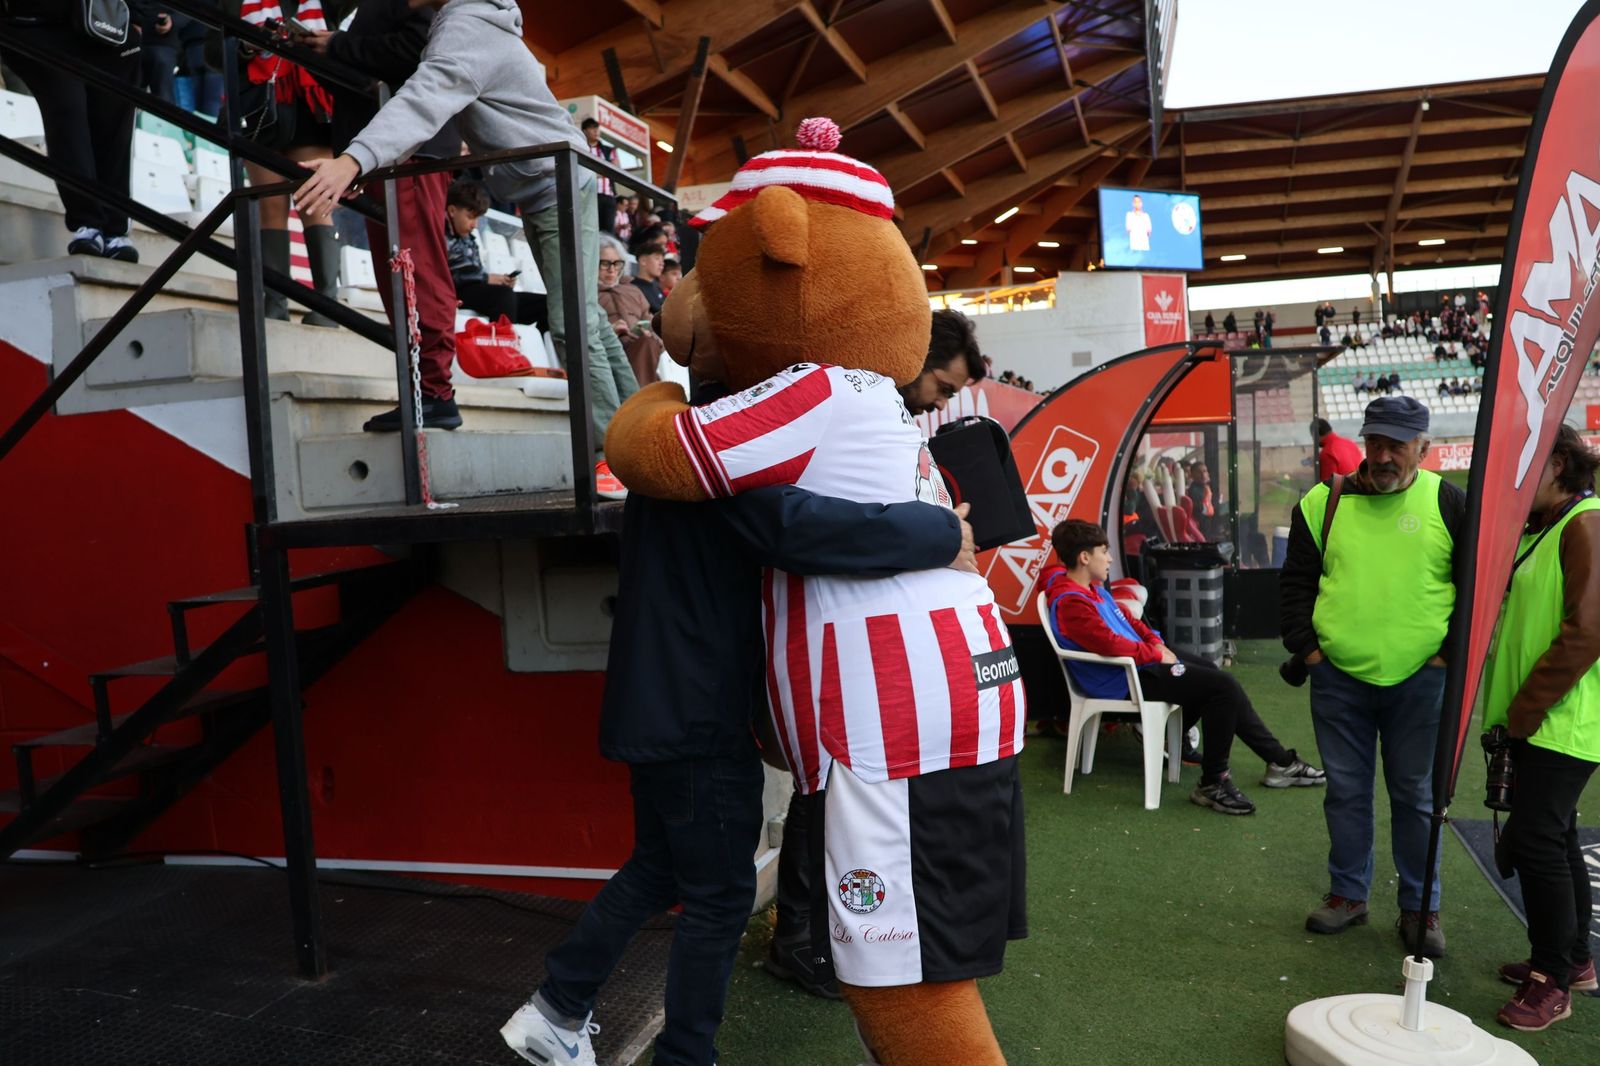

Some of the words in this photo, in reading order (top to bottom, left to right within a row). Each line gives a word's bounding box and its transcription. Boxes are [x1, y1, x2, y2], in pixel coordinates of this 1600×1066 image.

[1029, 503, 1070, 578] ALQUILES
[831, 922, 854, 944] La
[858, 923, 915, 944] Calesa
